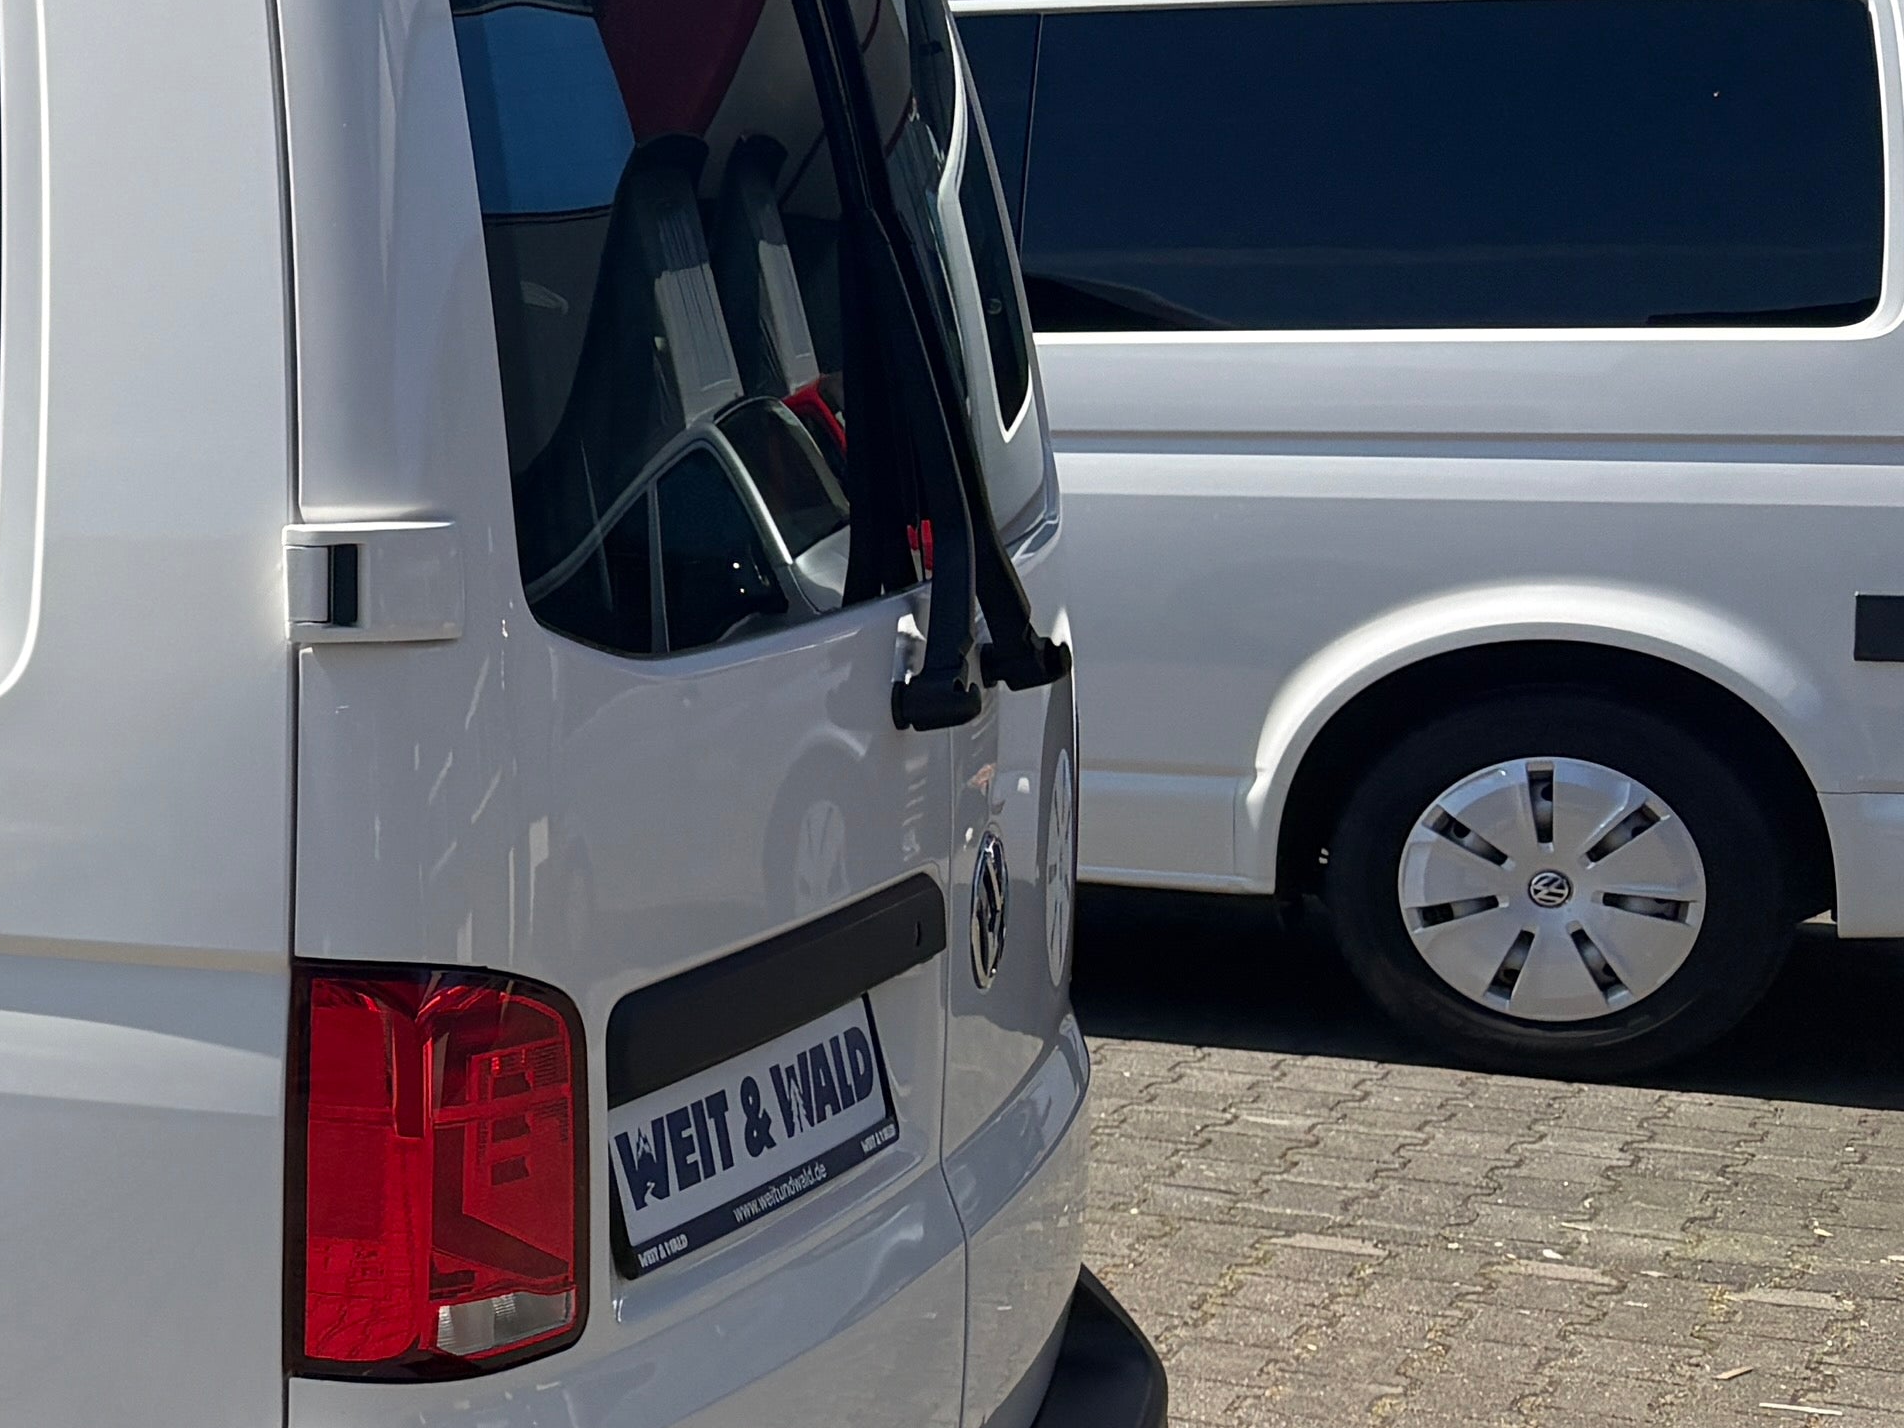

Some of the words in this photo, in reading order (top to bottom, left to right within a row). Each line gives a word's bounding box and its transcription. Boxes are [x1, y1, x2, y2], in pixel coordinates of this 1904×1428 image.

[614, 1089, 735, 1211] WEIT
[739, 1076, 777, 1158] &
[769, 1026, 874, 1139] WALD
[732, 1162, 828, 1223] www.weitundwald.de
